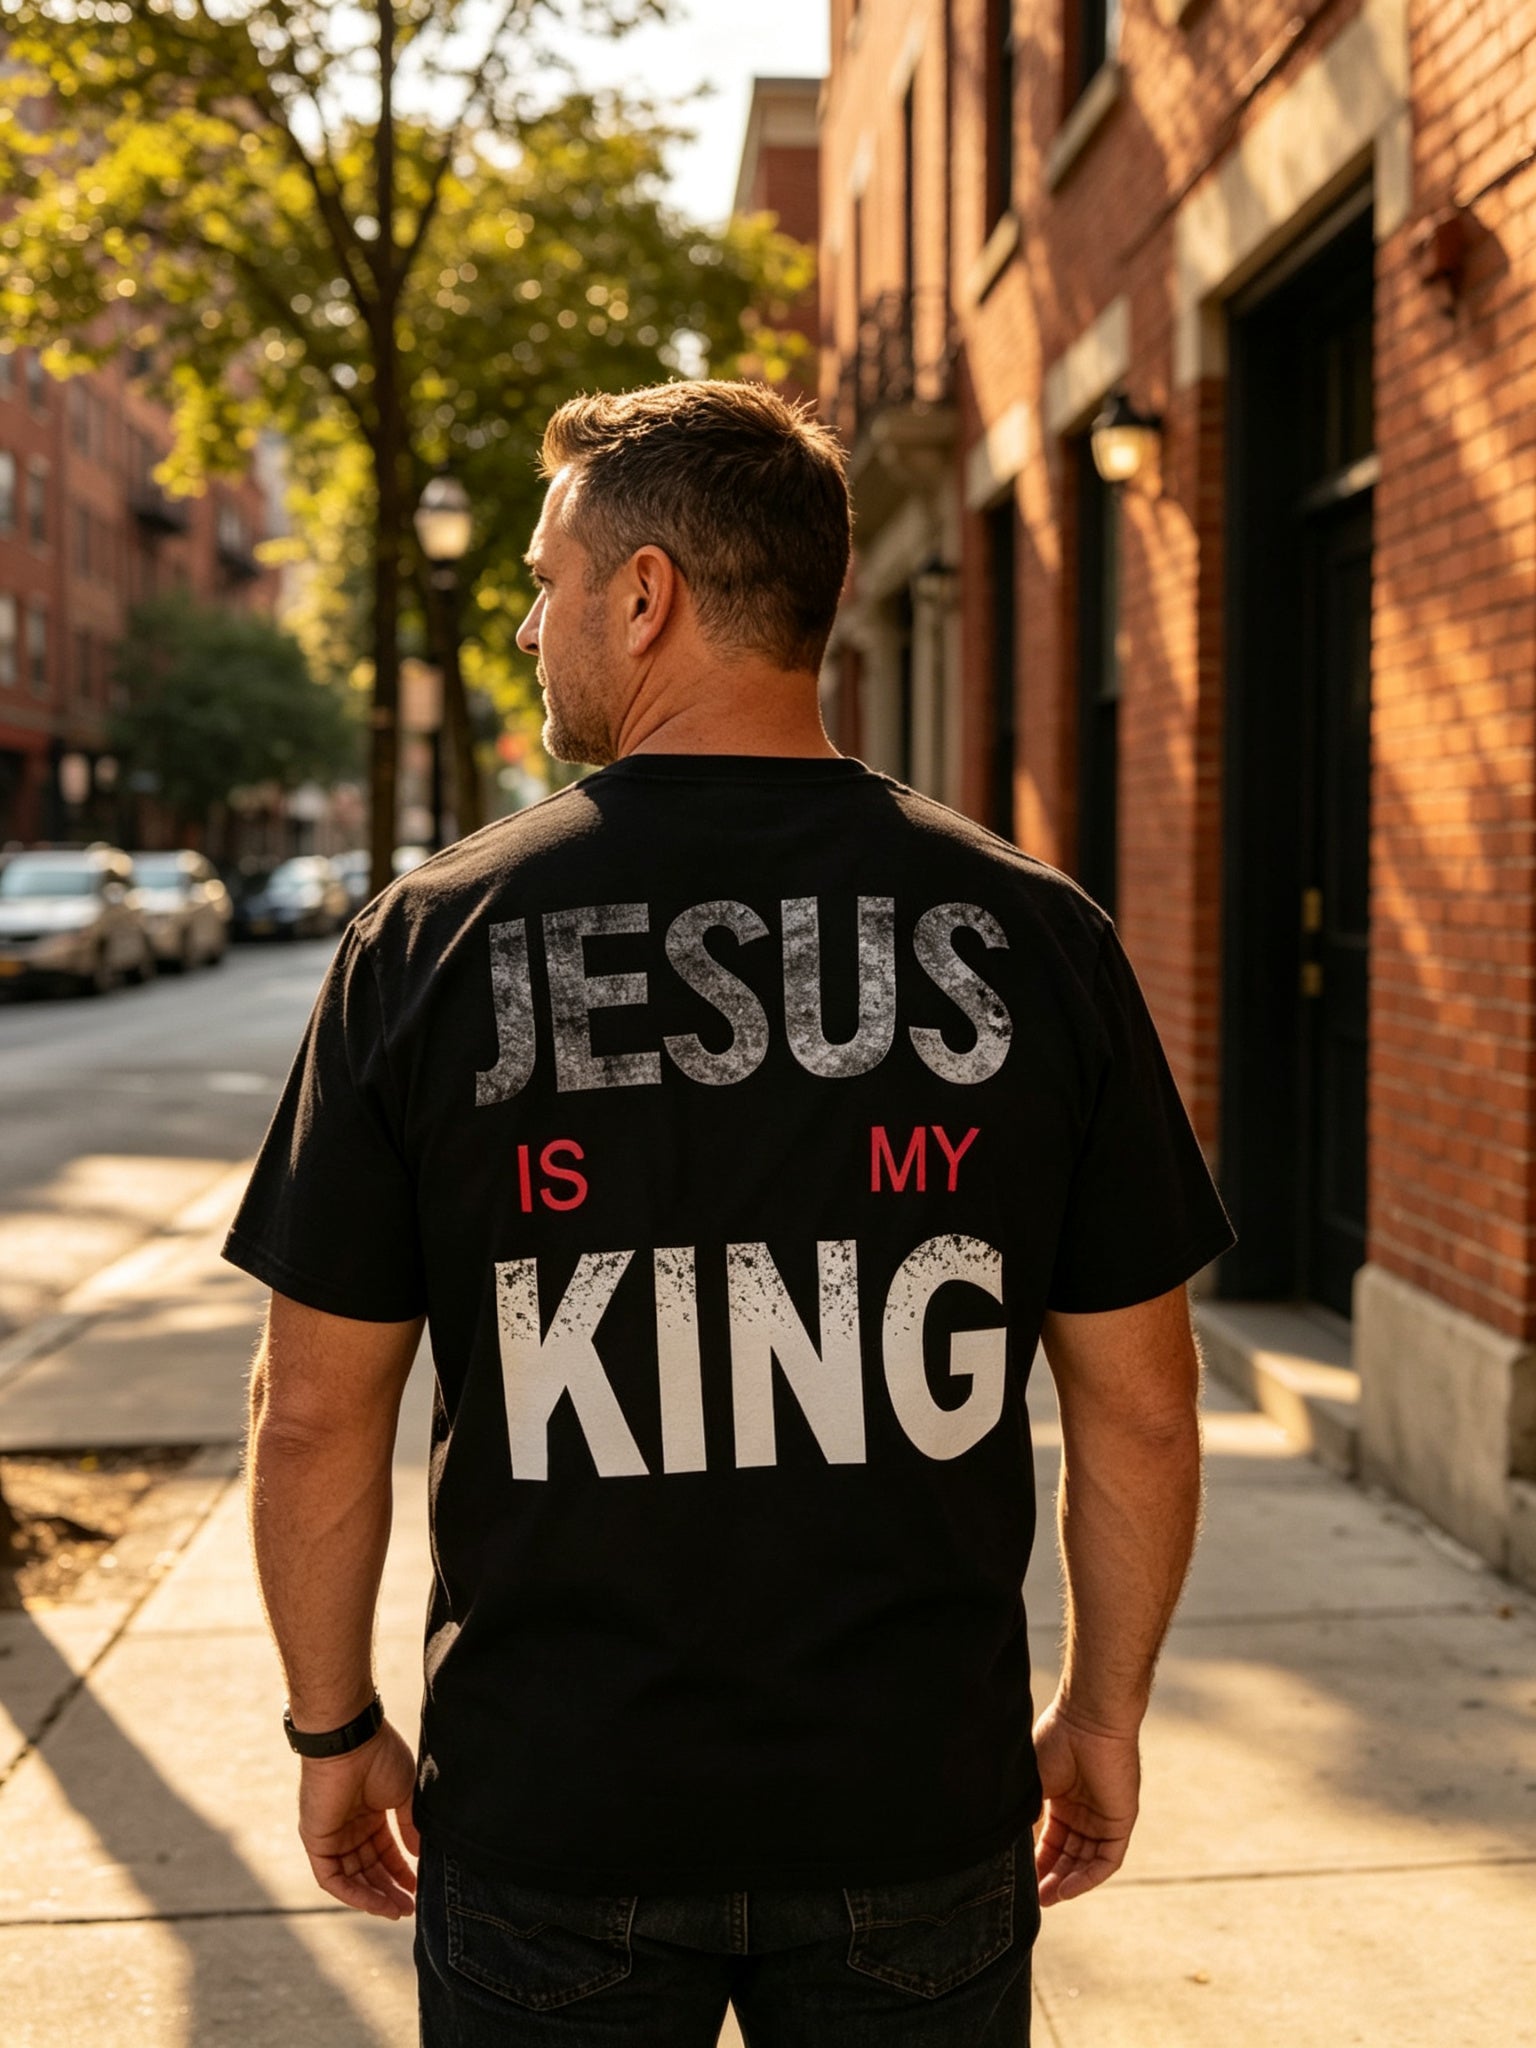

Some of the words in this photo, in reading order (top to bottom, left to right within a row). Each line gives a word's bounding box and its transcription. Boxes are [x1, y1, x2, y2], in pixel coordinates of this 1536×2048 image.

[474, 896, 1013, 1106] JESUS
[517, 1139, 589, 1213] IS
[870, 1125, 980, 1192] MY
[494, 1233, 1008, 1482] KING
